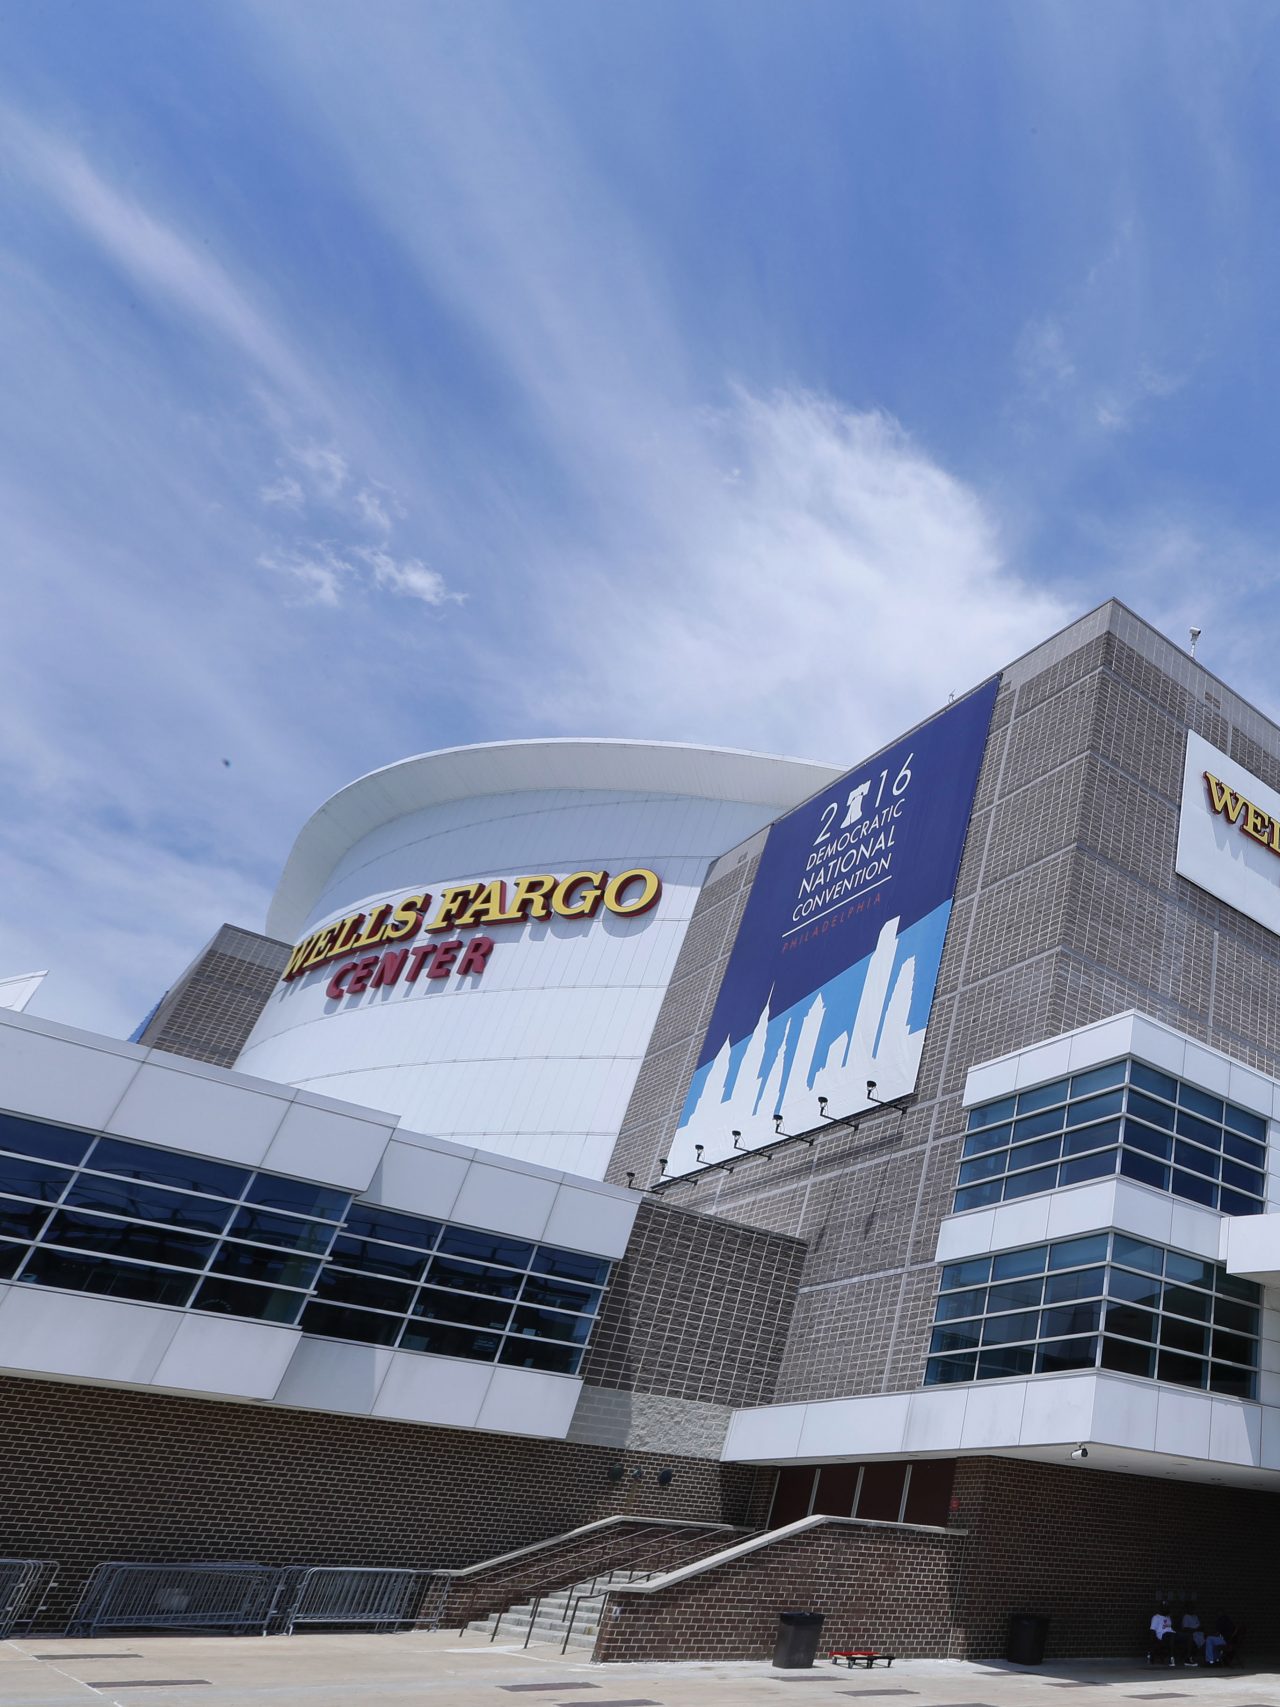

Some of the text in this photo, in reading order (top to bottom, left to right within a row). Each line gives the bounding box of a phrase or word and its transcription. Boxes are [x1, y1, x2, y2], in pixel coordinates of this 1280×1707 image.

[798, 825, 895, 899] NATIONAL
[806, 798, 905, 871] DEMOCRATIC
[782, 892, 881, 954] PHILADELPHIA
[792, 853, 892, 922] CONVENTION
[283, 868, 662, 983] WELLS FARGO
[326, 936, 494, 999] CENTER
